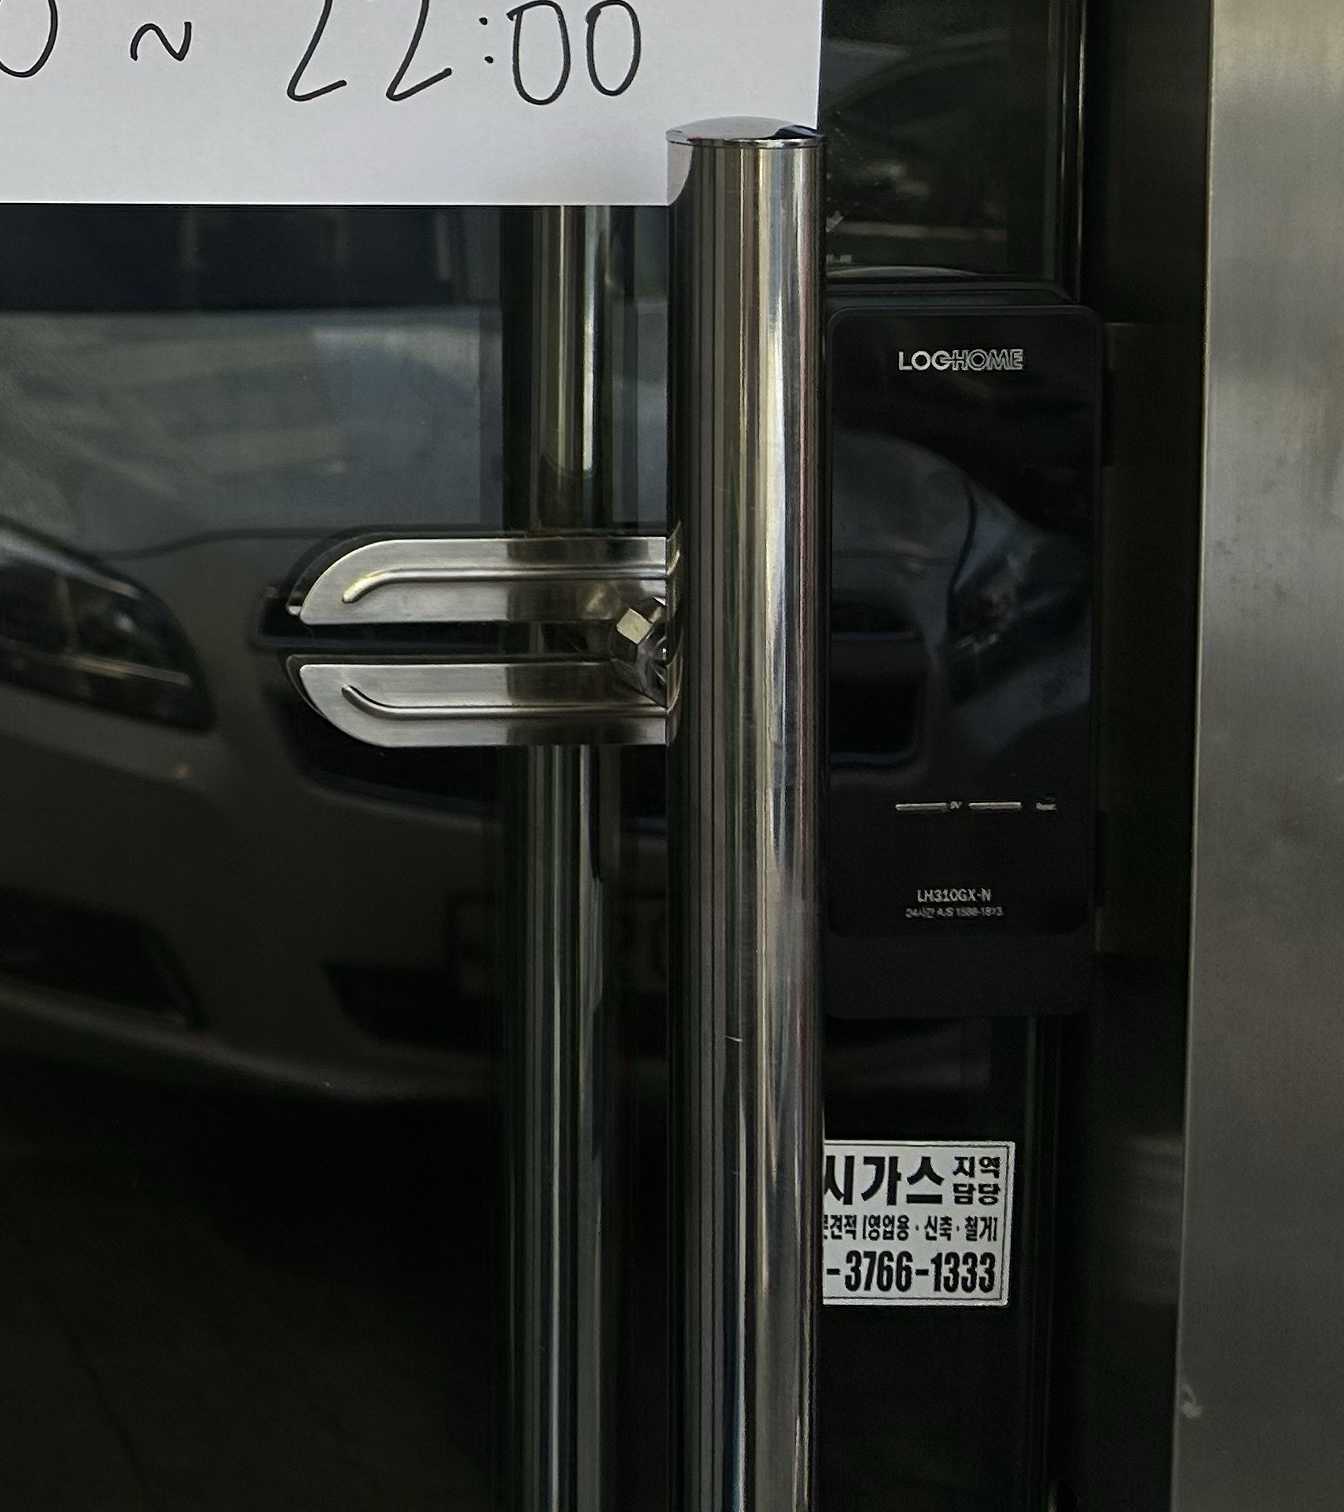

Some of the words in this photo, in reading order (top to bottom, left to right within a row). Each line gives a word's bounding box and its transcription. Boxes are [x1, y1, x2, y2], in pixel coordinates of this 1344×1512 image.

[898, 348, 1024, 372] LOGHOME
[952, 1155, 1001, 1179] 지역
[952, 1183, 1001, 1206] 담당
[923, 1215, 953, 1242] 신축
